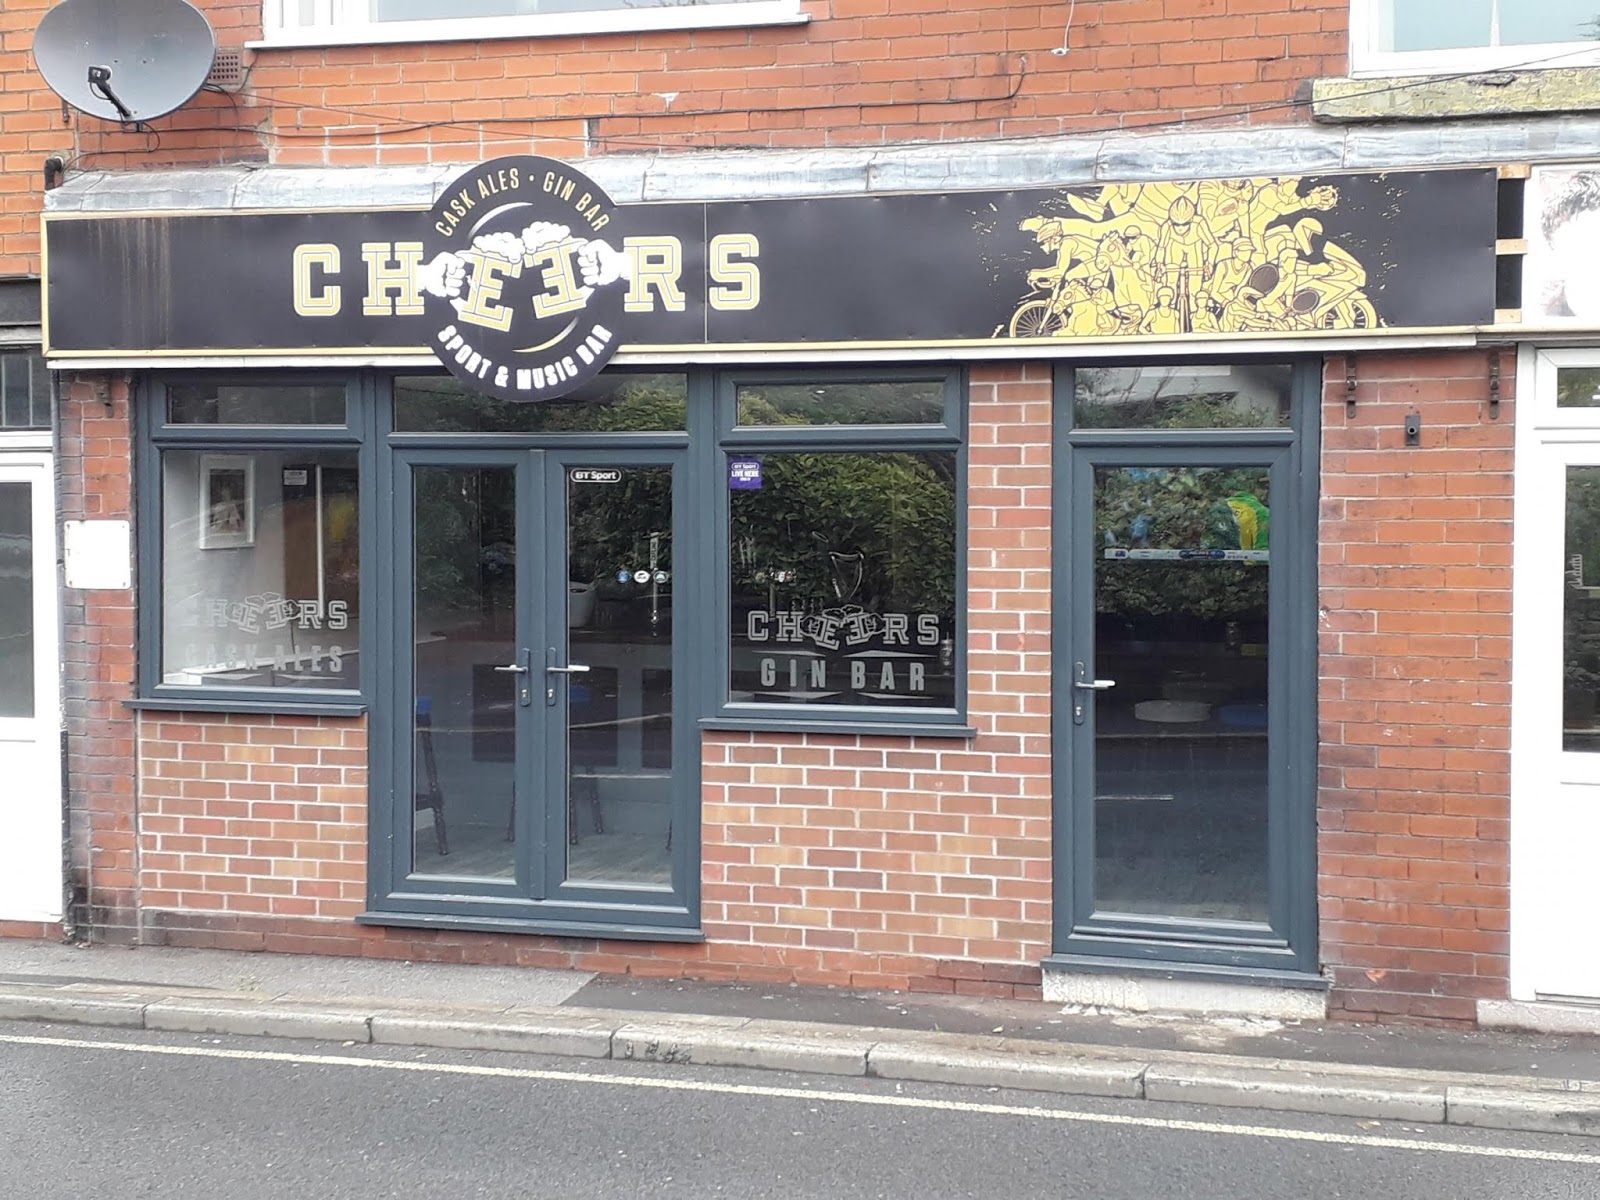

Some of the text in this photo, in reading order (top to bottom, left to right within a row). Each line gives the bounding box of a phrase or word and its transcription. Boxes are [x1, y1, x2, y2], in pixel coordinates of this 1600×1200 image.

[435, 167, 610, 237] CASK ALES GIN BAR
[292, 233, 761, 332] CHEERS
[437, 324, 613, 390] SPORT & MUSIC BAR
[575, 470, 616, 480] BT Sport
[747, 610, 940, 650] CHEERS
[273, 644, 343, 672] ALES
[760, 658, 925, 691] GIN BAR
